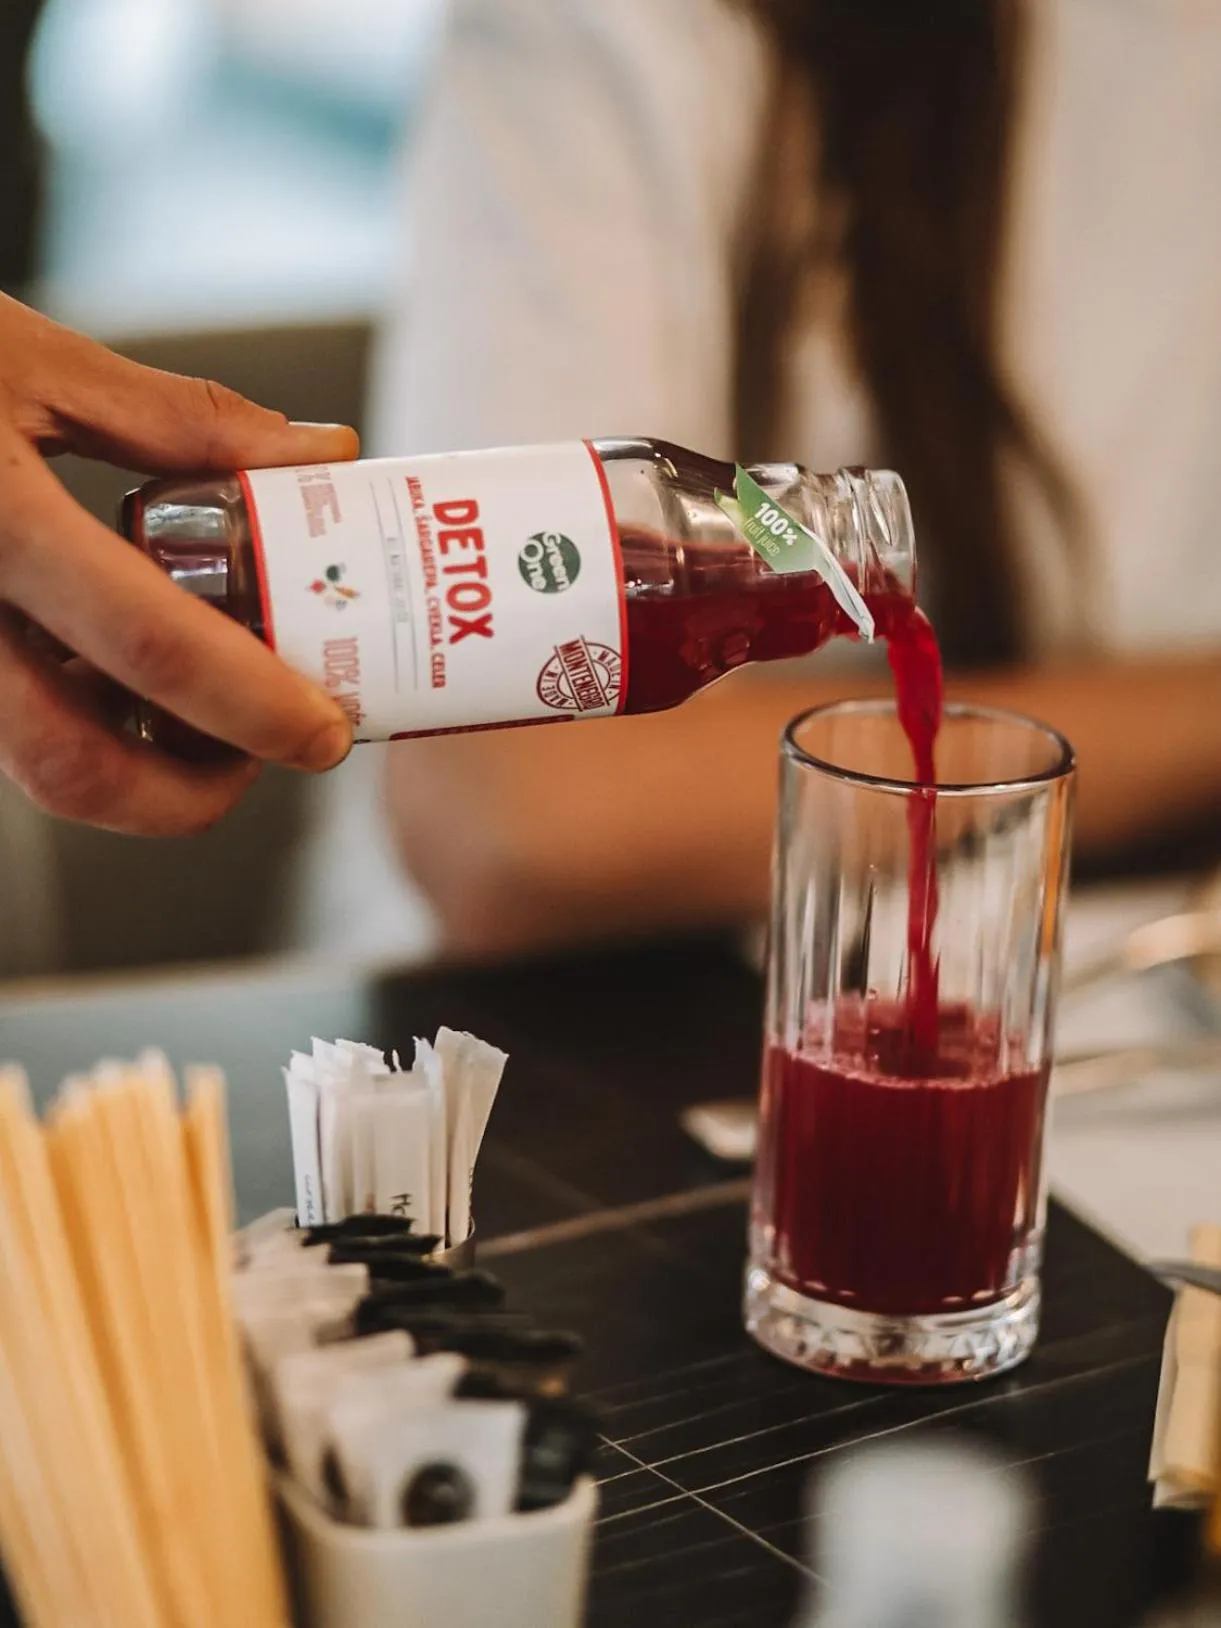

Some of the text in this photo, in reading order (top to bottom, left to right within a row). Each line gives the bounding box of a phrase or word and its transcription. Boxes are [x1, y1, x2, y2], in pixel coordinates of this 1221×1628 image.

[754, 502, 798, 546] 100%
[432, 498, 495, 645] DETOX
[519, 538, 548, 591] One
[542, 531, 571, 592] Green
[323, 635, 361, 689] 100%
[430, 653, 447, 689] CELER
[559, 639, 606, 711] MONTENEGRO
